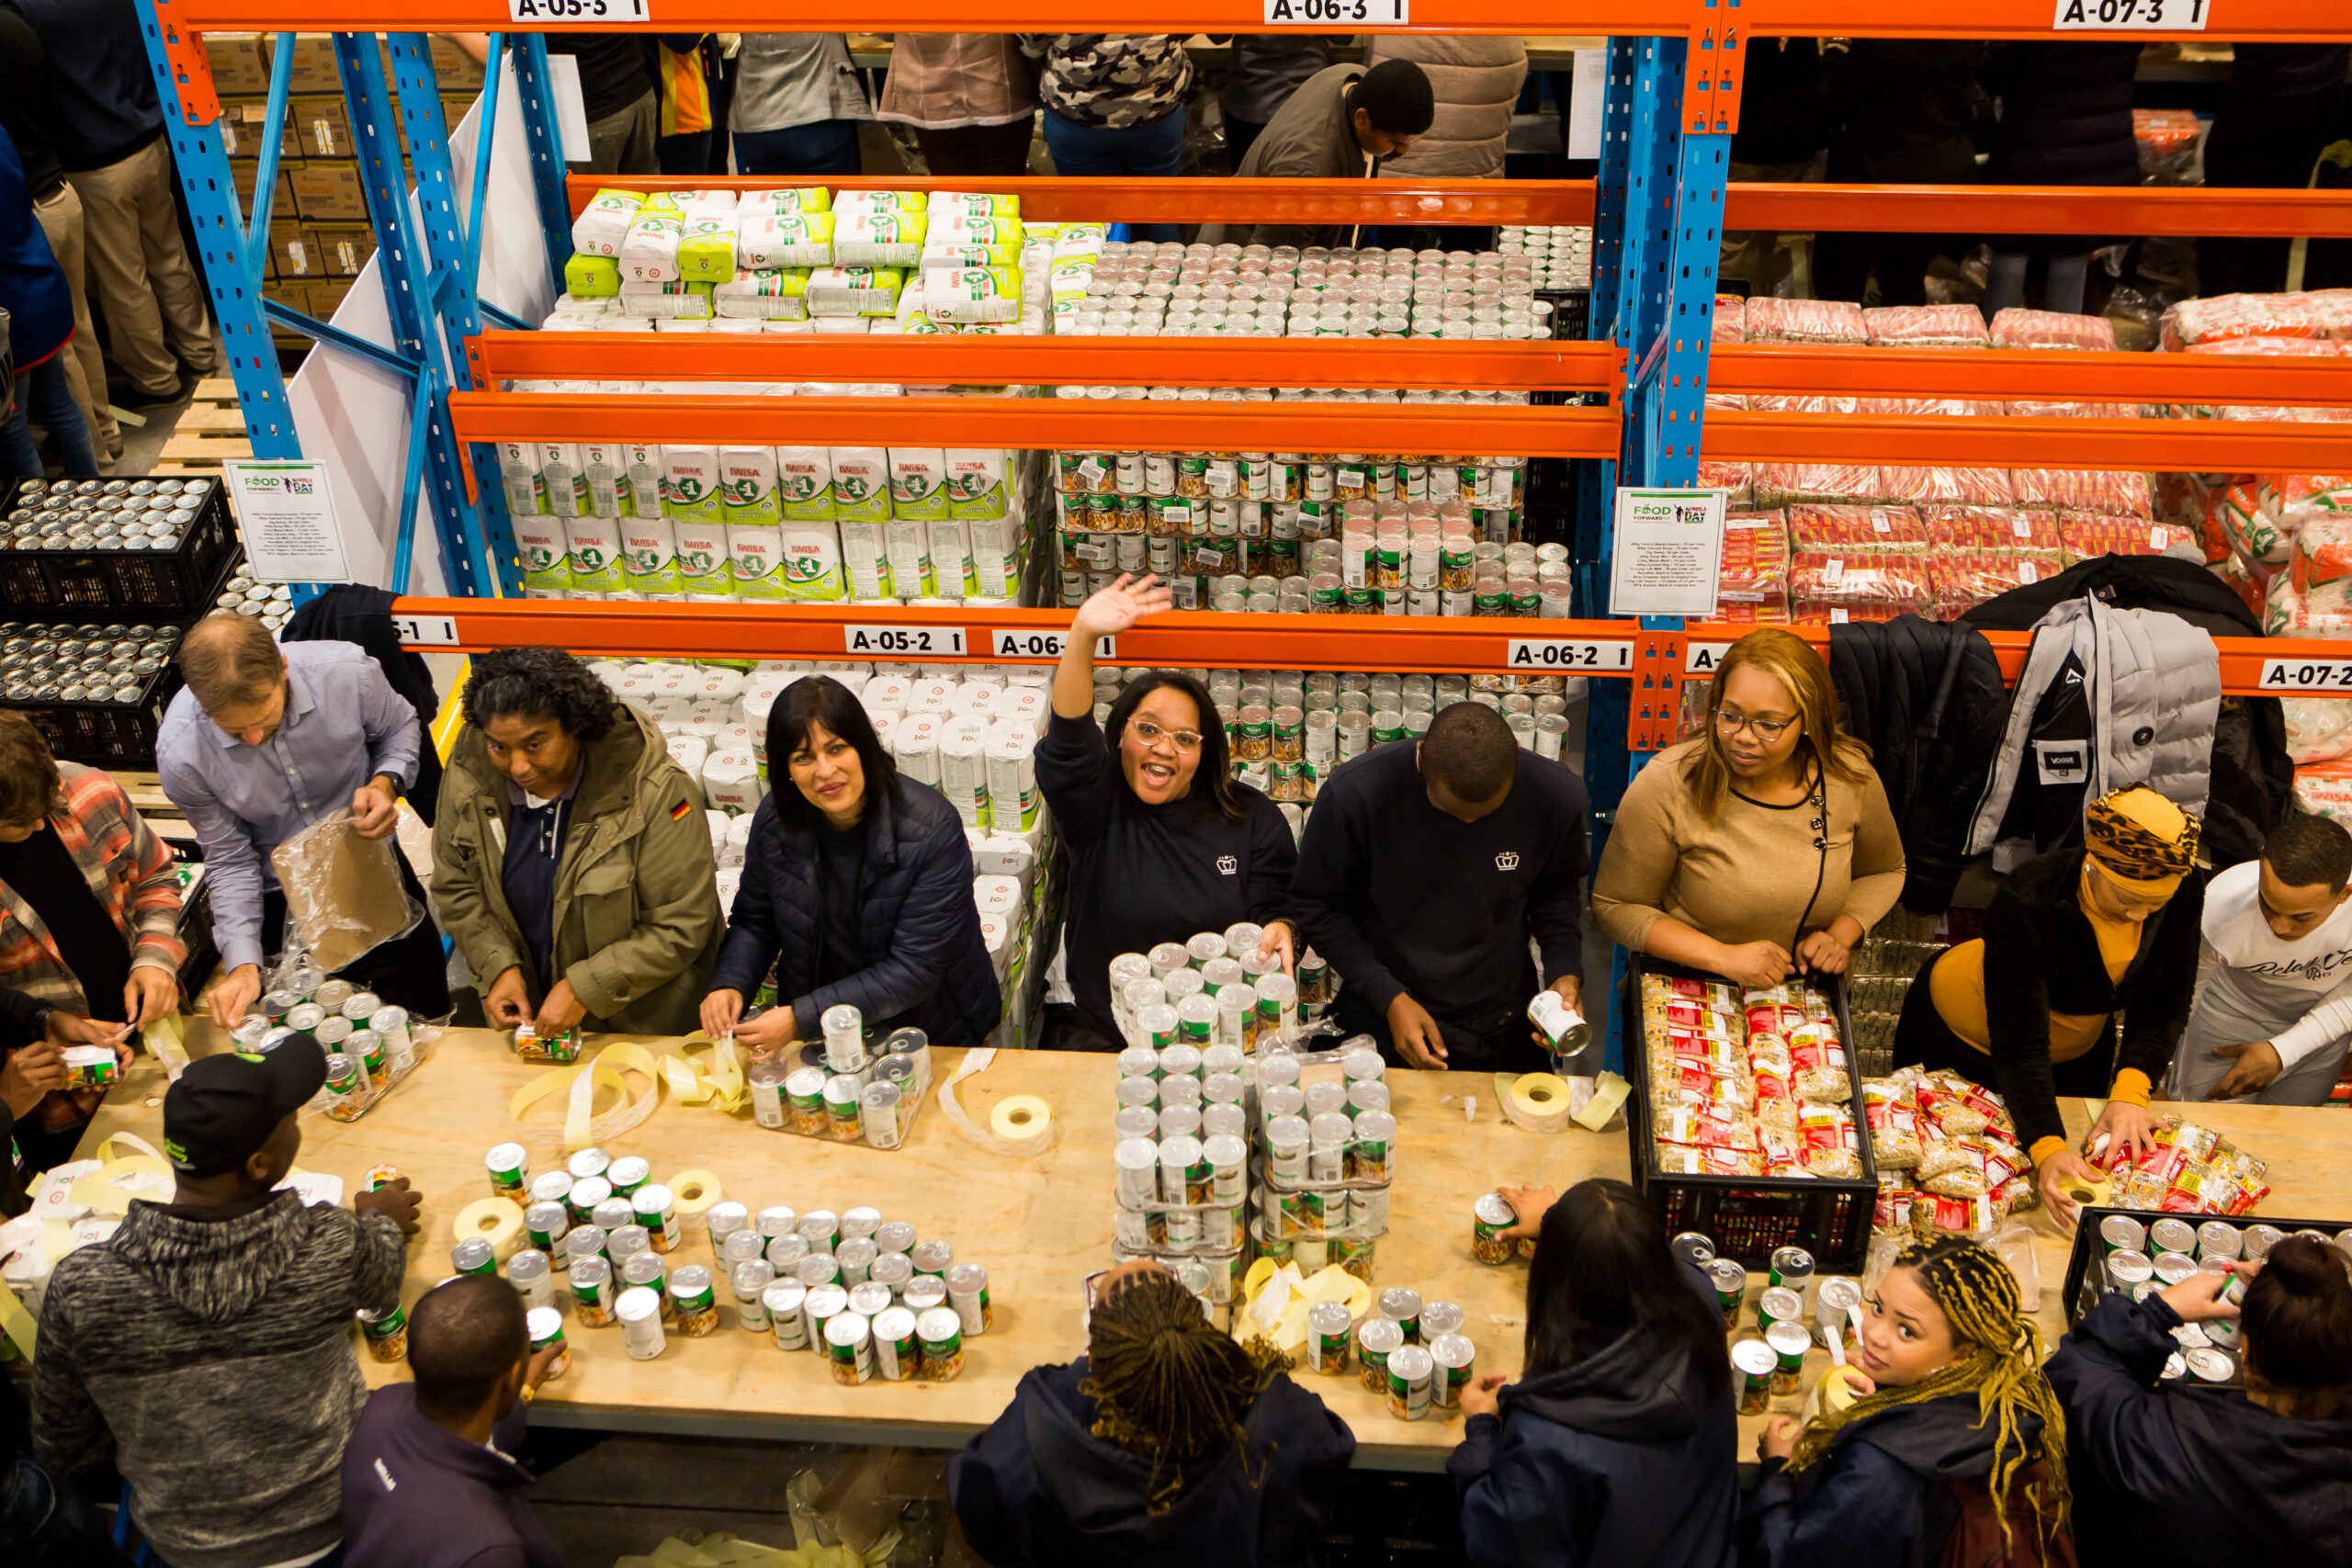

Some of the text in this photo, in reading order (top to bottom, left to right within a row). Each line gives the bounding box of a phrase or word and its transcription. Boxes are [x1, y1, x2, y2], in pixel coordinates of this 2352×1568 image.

[1272, 0, 1367, 20] A-06-3
[2063, 0, 2164, 23] A-07-3
[729, 468, 760, 477] IWISA
[786, 463, 816, 473] IWISA
[839, 465, 869, 474] IWISA
[899, 463, 929, 472] IWISA
[244, 476, 279, 486] FOOD
[1634, 504, 1671, 515] FOOD
[1684, 512, 1705, 522] DAY
[574, 536, 604, 546] IWISA
[684, 540, 713, 549] IWISA
[737, 544, 766, 553] IWISA
[791, 545, 821, 553] IWISA
[852, 631, 933, 650] A-05-2
[1001, 636, 1066, 655] A-06-
[1514, 645, 1598, 665] A-06-2
[2267, 665, 2352, 685] A-07-2
